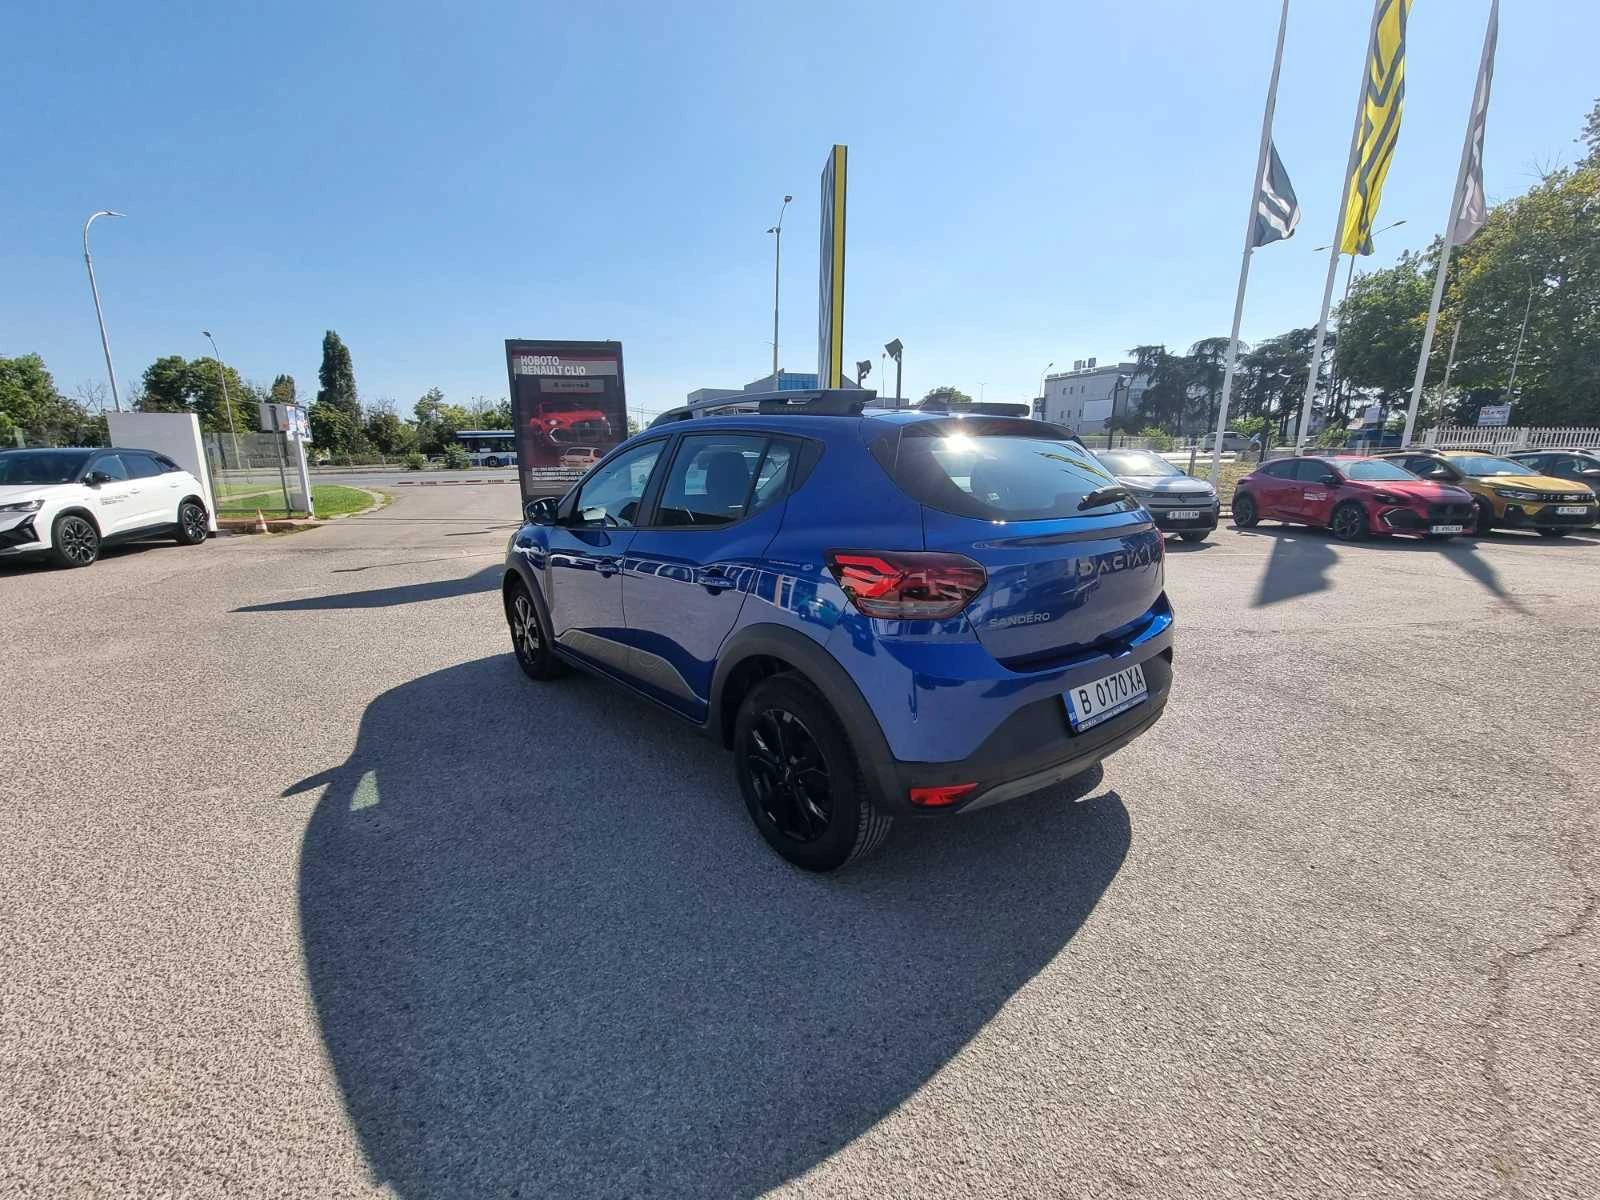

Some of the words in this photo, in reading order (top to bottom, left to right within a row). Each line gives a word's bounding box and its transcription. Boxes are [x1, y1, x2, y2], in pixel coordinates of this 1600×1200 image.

[520, 355, 560, 366] НОВОТО
[521, 365, 563, 376] RENAULT
[564, 365, 586, 376] CLIO
[1079, 552, 1142, 577] DACIA
[990, 611, 1050, 626] SANDERO
